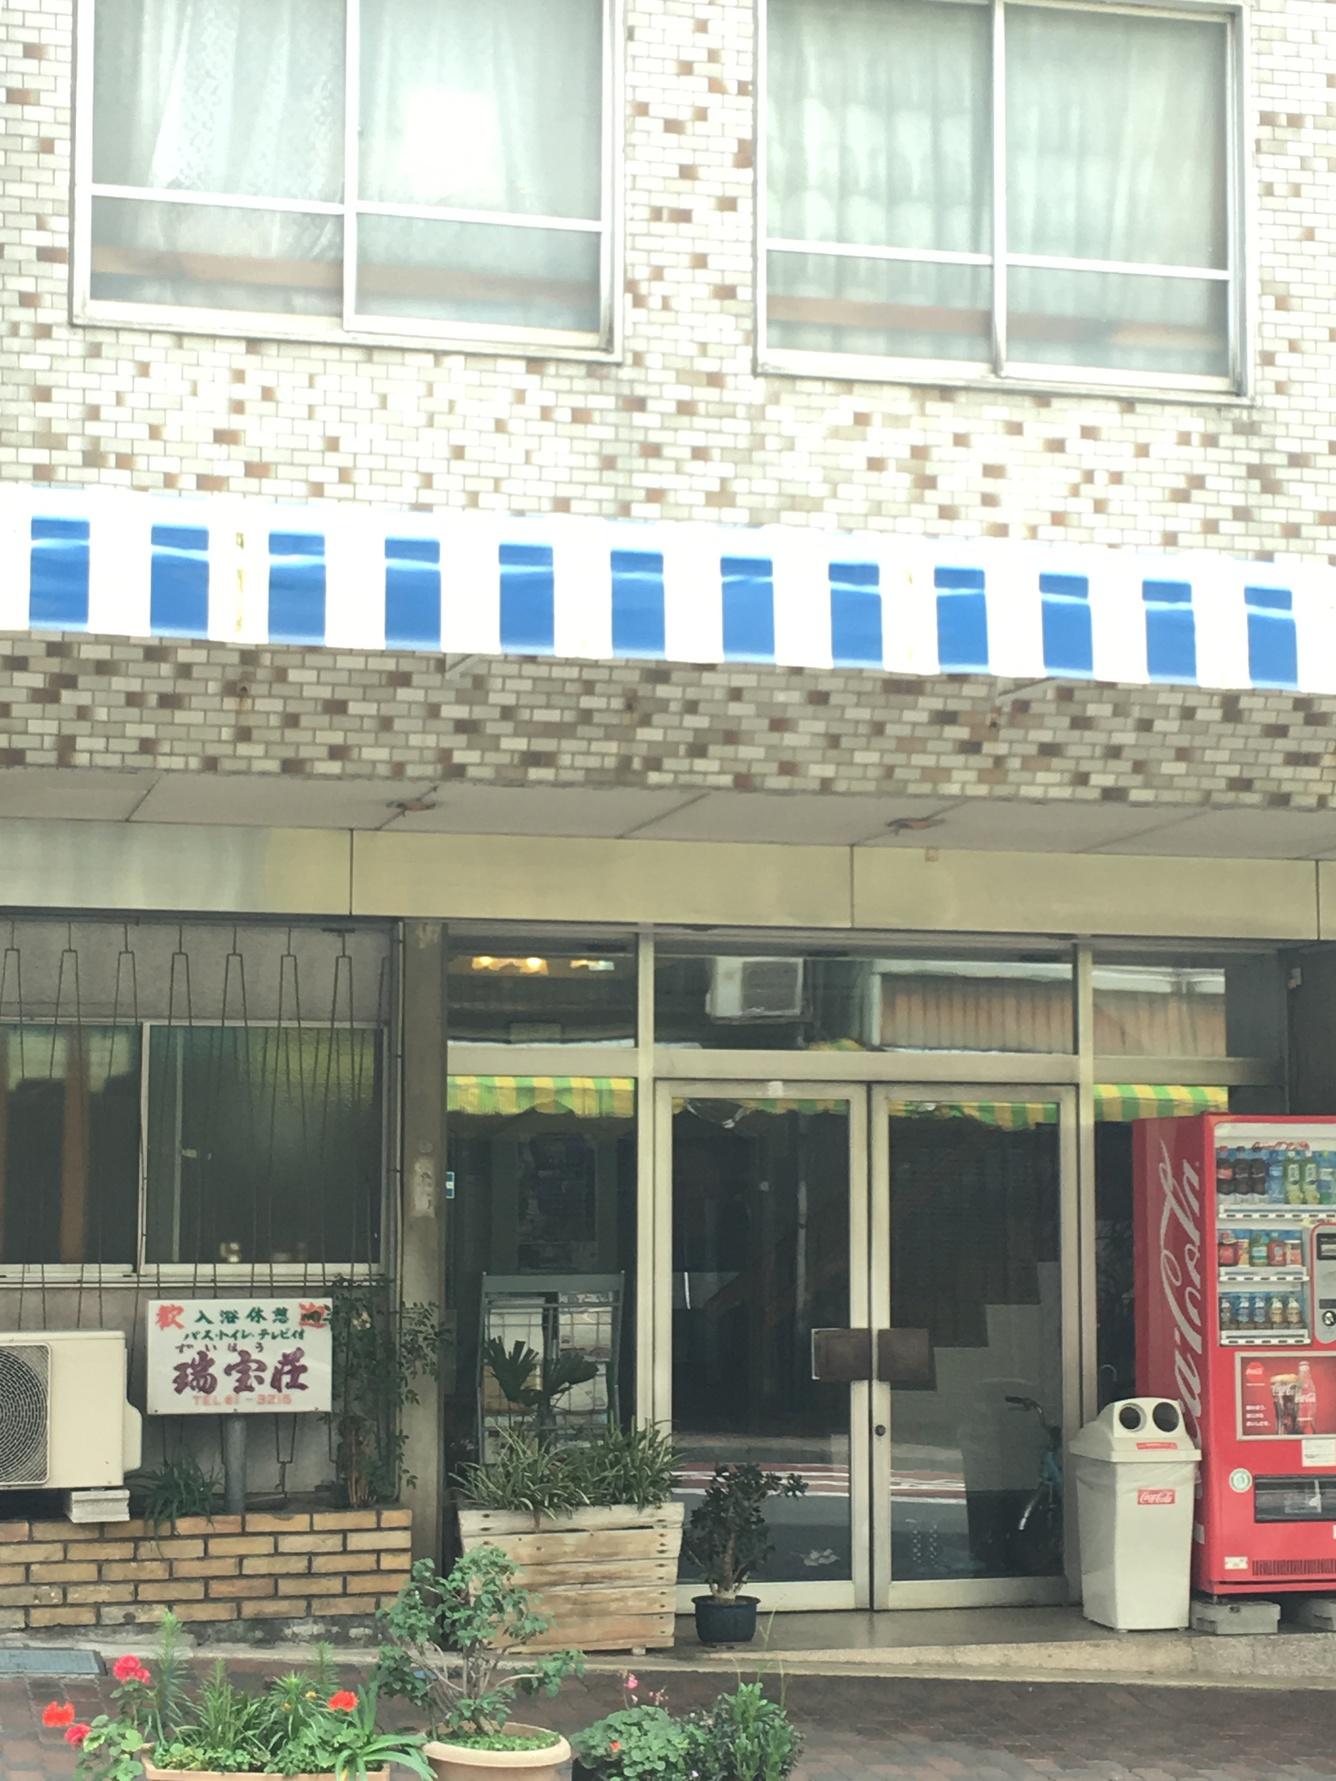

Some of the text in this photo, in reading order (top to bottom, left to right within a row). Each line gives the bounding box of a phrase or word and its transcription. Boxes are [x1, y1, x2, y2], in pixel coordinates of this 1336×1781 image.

[155, 1304, 186, 1331] 歓
[194, 1306, 290, 1325] 入浴休憩
[172, 1347, 309, 1395] 瑞宝荘
[193, 1394, 221, 1406] TEL
